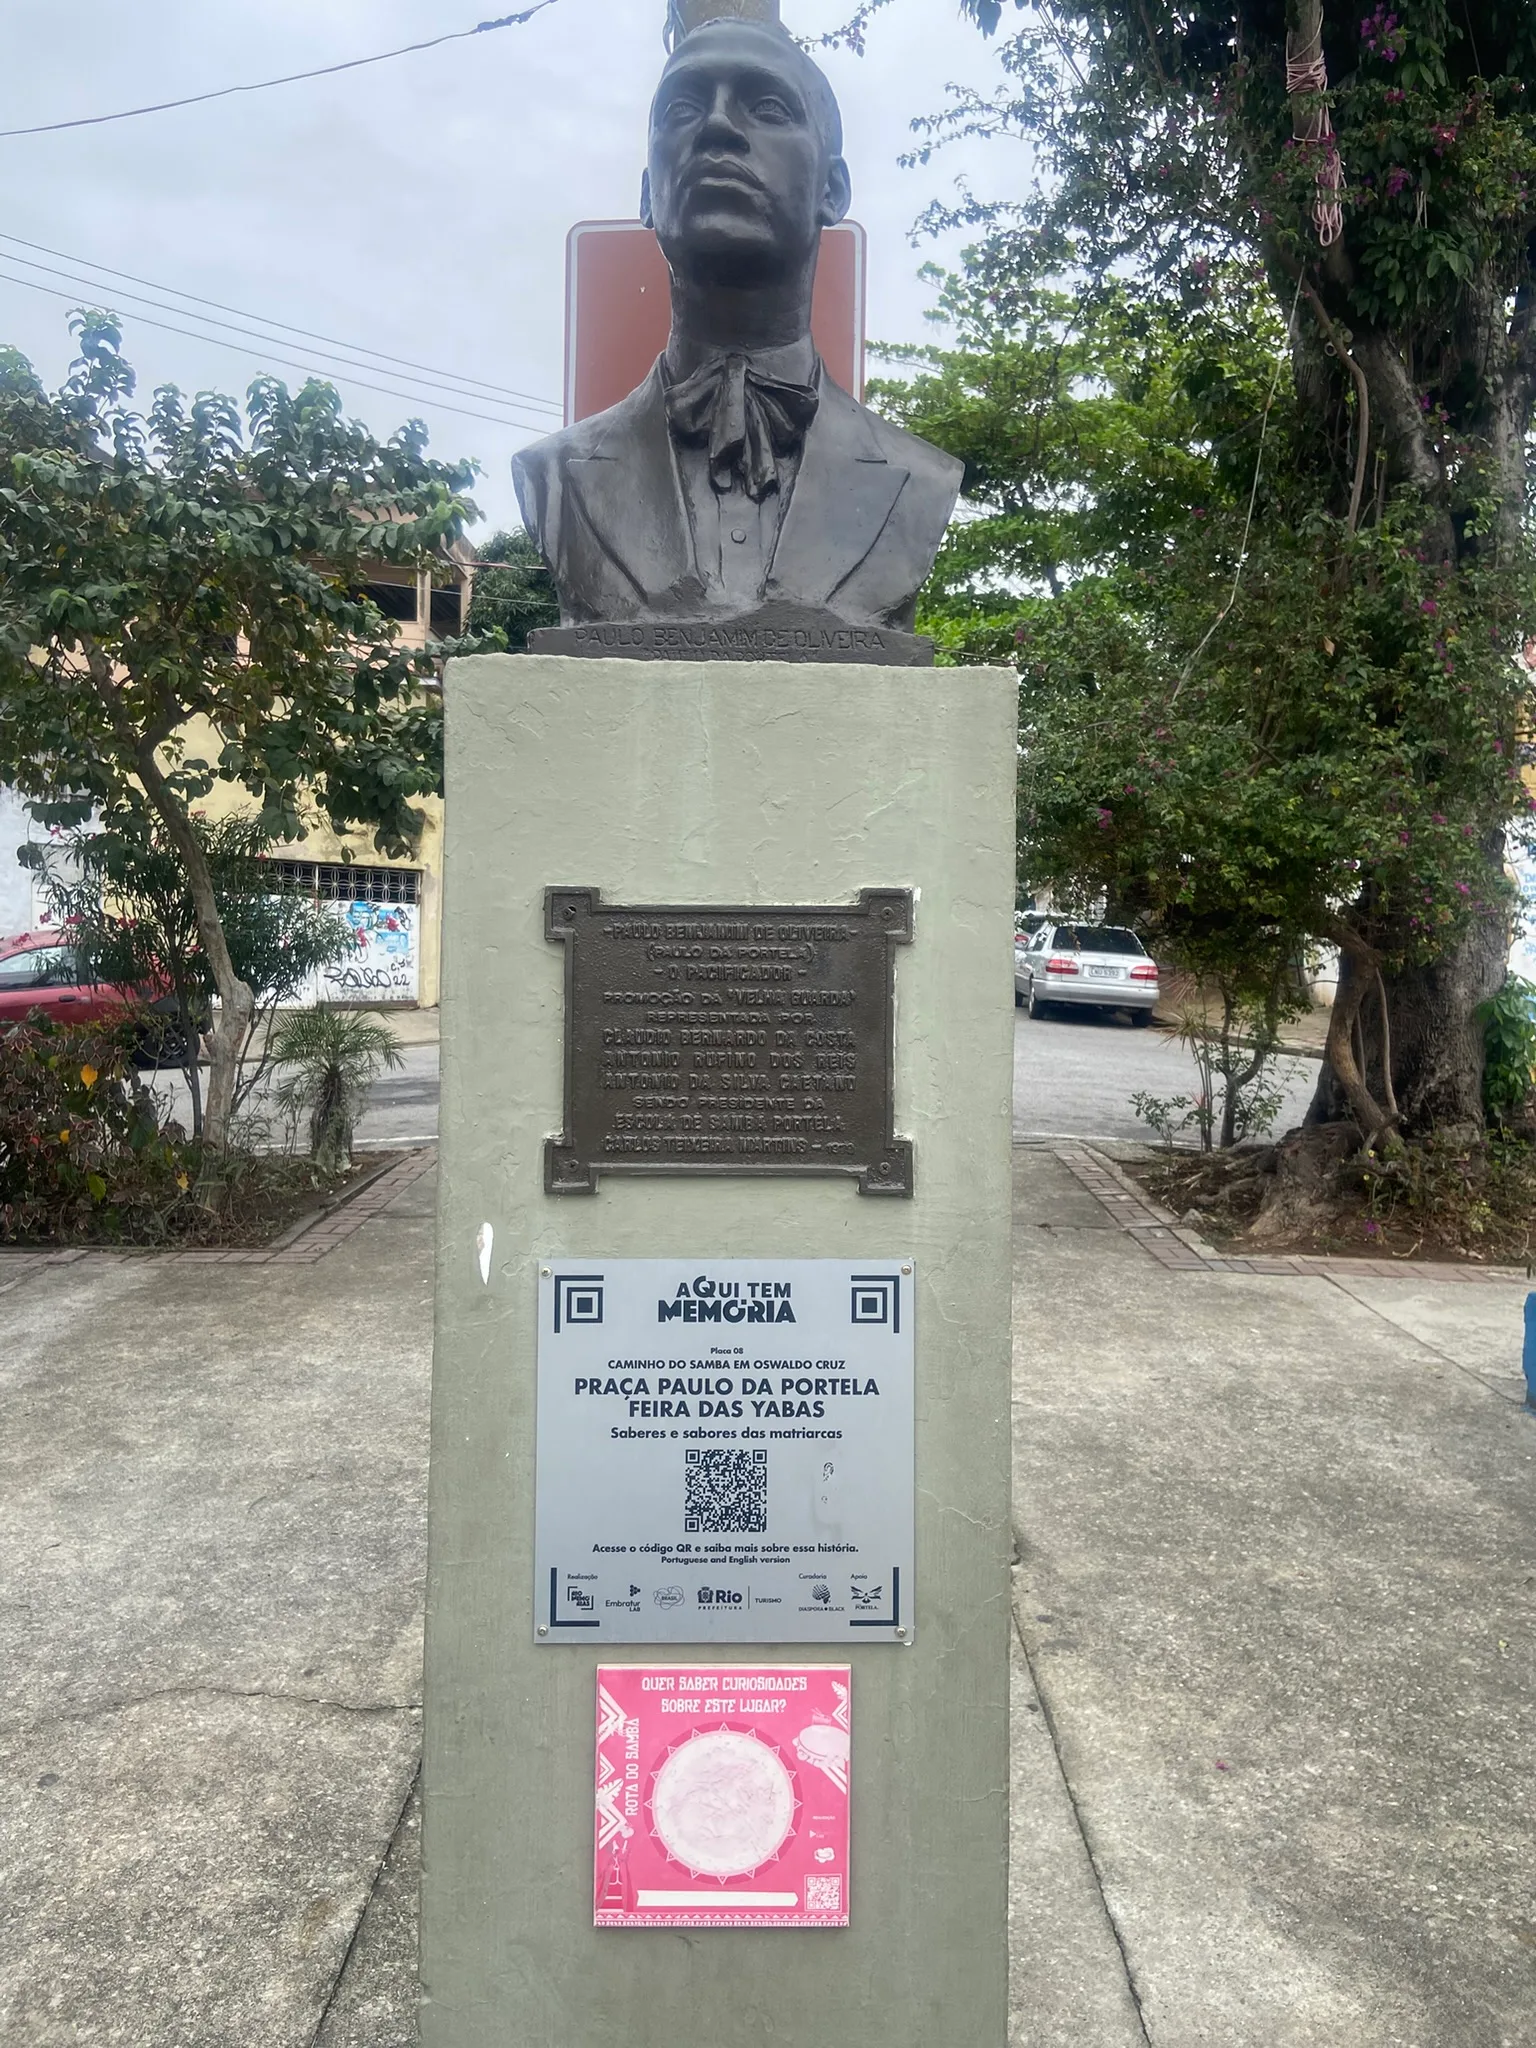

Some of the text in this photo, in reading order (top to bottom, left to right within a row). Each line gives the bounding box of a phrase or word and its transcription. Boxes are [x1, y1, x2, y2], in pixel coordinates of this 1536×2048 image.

[574, 627, 644, 648] PAULO
[763, 629, 789, 648] DE
[794, 630, 886, 650] OLIVEIRA
[753, 924, 775, 941] DE
[710, 945, 734, 958] DA
[687, 964, 793, 981] PACIFICADOR
[701, 991, 723, 1005] DA
[647, 1011, 817, 1025] REPRESENTADA POR
[680, 1028, 767, 1047] BERNARDO
[775, 1030, 796, 1047] DA
[805, 1030, 856, 1047] COSTA
[693, 1051, 756, 1069] RUFINO
[770, 1052, 804, 1069] DOS
[816, 1052, 857, 1069] REIS
[689, 1073, 711, 1090] DA
[721, 1073, 771, 1091] SILVA
[780, 1074, 856, 1092] CAETANO
[632, 1095, 826, 1111] SENDO PRESIDENTE DA
[613, 1113, 847, 1132] ESCOLA DE SAMBA PORTELA
[603, 1135, 661, 1153] CARLOS
[663, 1136, 735, 1153] TEIXEIRA
[740, 1136, 808, 1153] MARTINS
[676, 1276, 792, 1299] AQUI TEM
[710, 1346, 744, 1355] Placa 08
[608, 1360, 846, 1370] CAMINHO DO SAMBA EM OSWALDO CRUZ
[574, 1378, 880, 1401] PRAÇA PAULO DA PORTELA
[629, 1401, 825, 1418] FEIRA DAS YABAS
[611, 1426, 843, 1439] Saberes e sabores das matriarcas
[592, 1544, 626, 1553] Acesse
[639, 1543, 673, 1555] código
[676, 1544, 692, 1553] QR
[704, 1543, 731, 1553] saiba
[735, 1543, 758, 1553] mais
[761, 1543, 790, 1553] sobre
[793, 1545, 815, 1553] essa
[818, 1543, 859, 1553] história.
[661, 1555, 791, 1566] Portuguese and English version
[605, 1600, 640, 1608] Embratur
[716, 1589, 743, 1604] Rio
[642, 1676, 808, 1692] QUER SABER CURIOSIDADES
[661, 1698, 787, 1713] SOBRE ESTE LUGAR?
[625, 1718, 640, 1816] ROTA DO SAMBA
